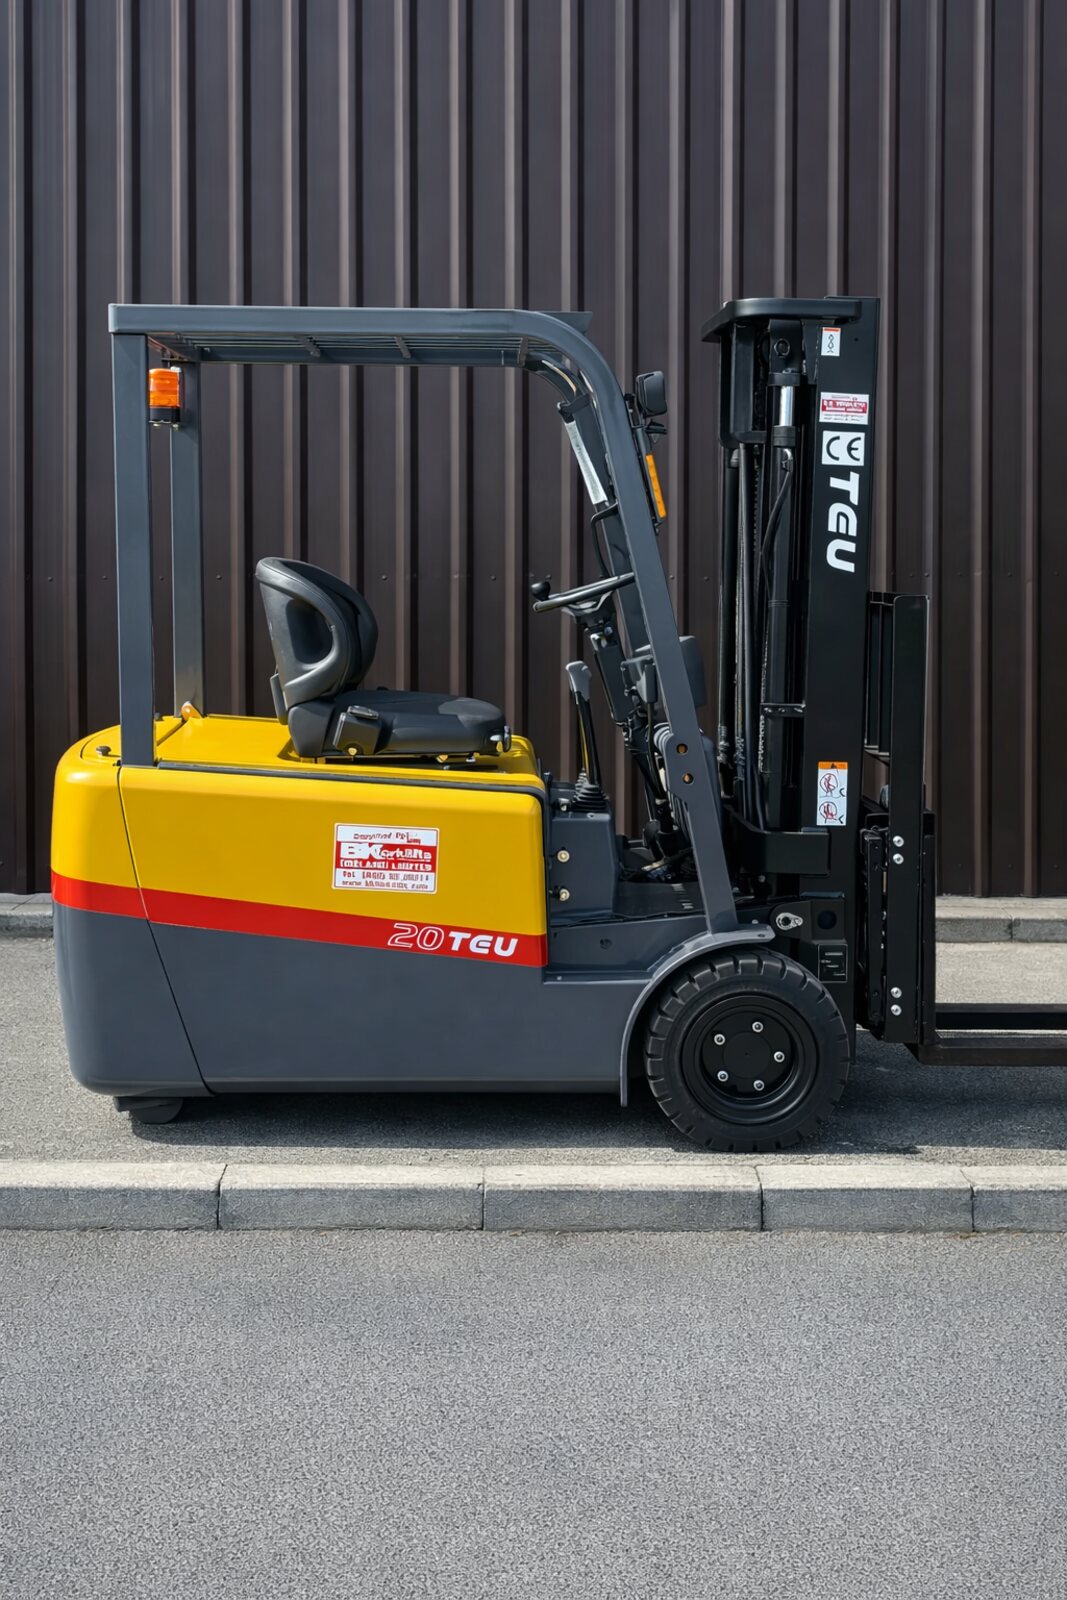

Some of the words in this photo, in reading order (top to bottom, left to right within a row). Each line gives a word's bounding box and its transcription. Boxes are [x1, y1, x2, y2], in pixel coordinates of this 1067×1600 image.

[826, 436, 862, 461] CE
[826, 471, 860, 573] TEU
[387, 923, 445, 951] 20
[448, 931, 518, 957] TEU
